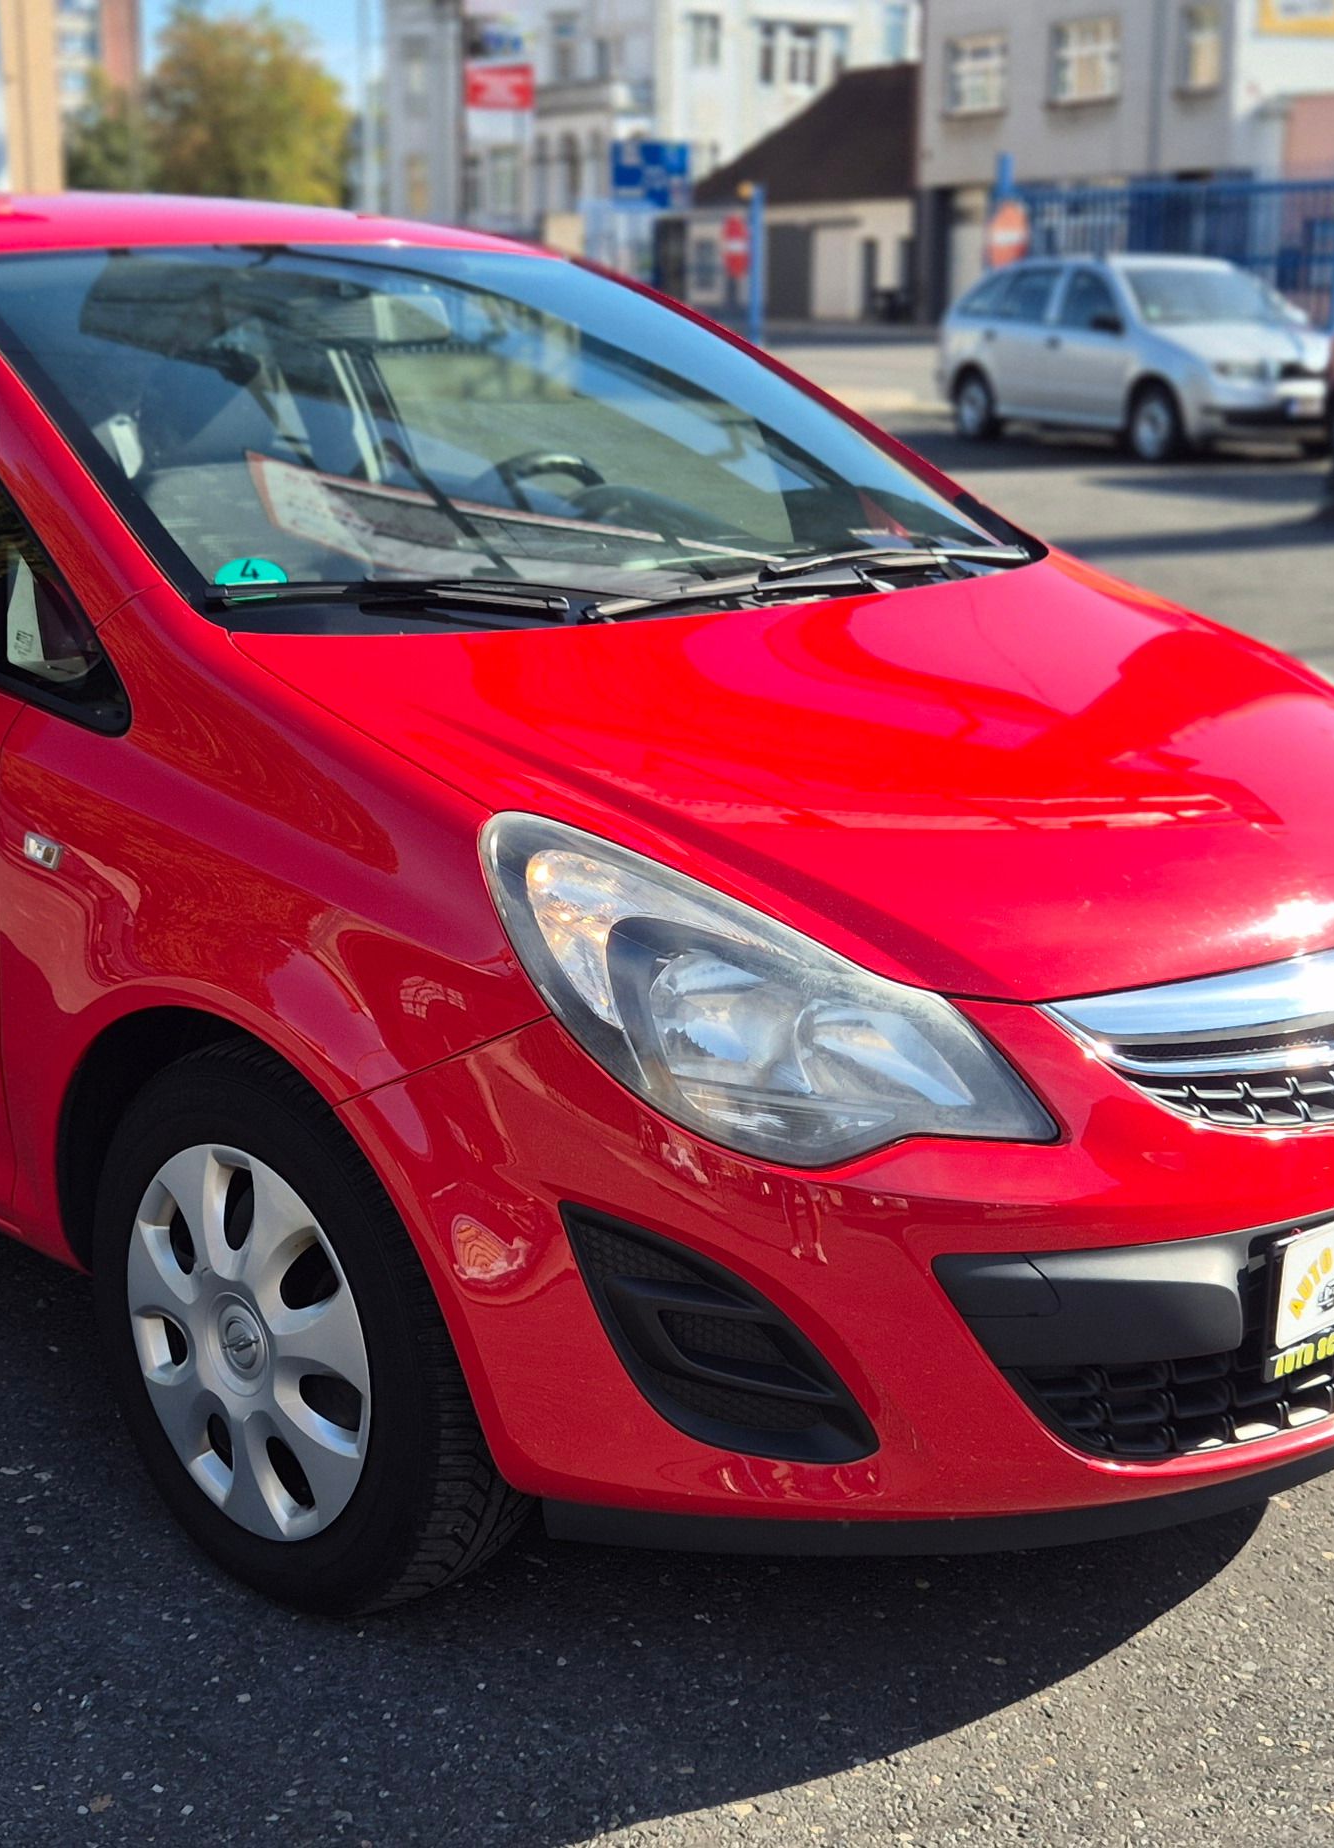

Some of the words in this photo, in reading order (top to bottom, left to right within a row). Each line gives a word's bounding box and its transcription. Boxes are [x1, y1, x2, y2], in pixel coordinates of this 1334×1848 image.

[240, 559, 259, 579] 4
[1288, 1247, 1333, 1320] AUTO
[1274, 1343, 1315, 1378] AUTO
